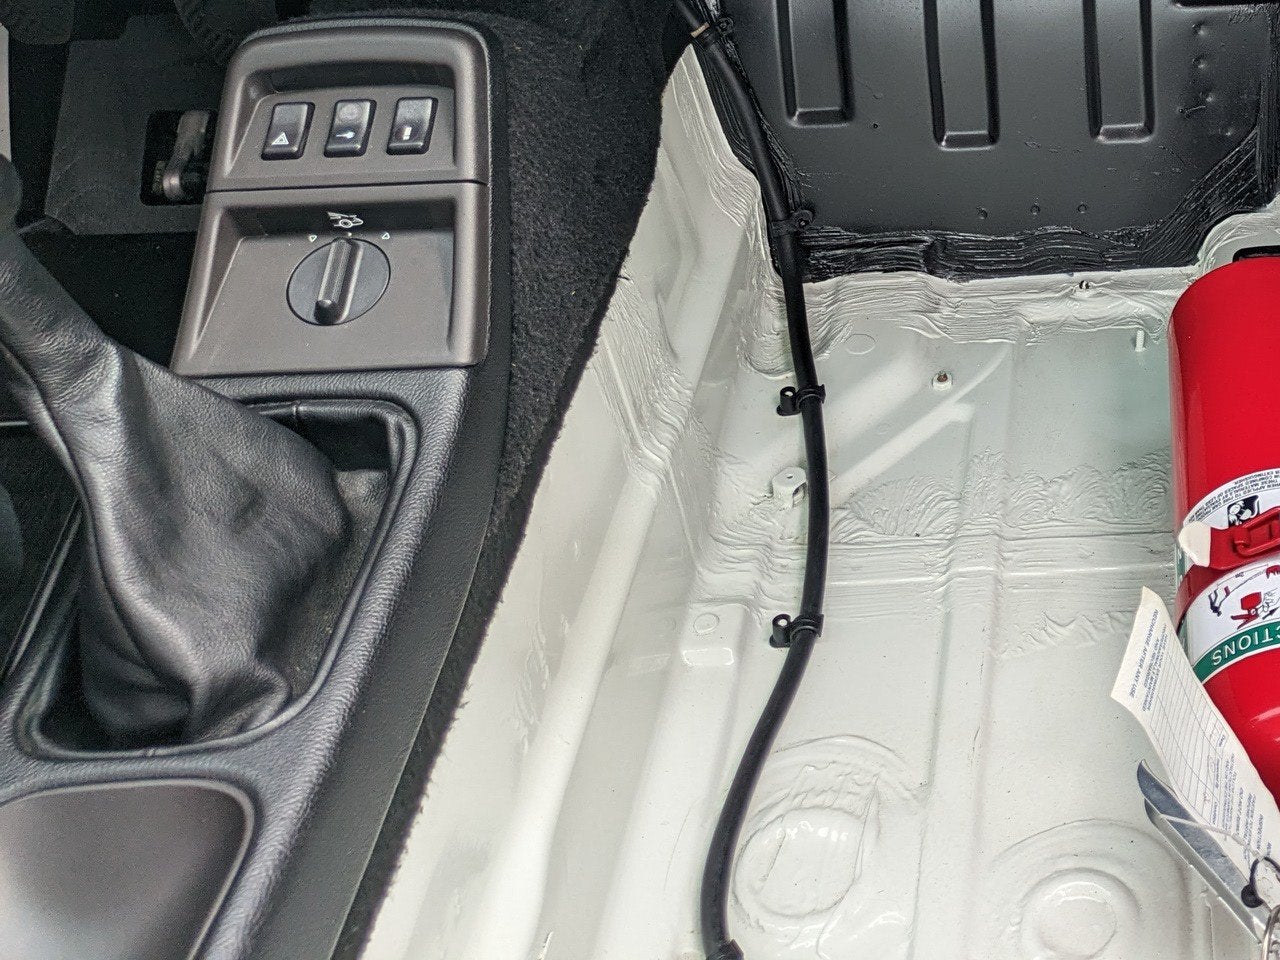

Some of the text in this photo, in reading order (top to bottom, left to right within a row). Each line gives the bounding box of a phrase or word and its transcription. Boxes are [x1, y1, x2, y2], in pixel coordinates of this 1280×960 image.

[1144, 609, 1159, 646] RECHARGE
[1138, 646, 1148, 669] AFTER
[1129, 683, 1138, 699] USE
